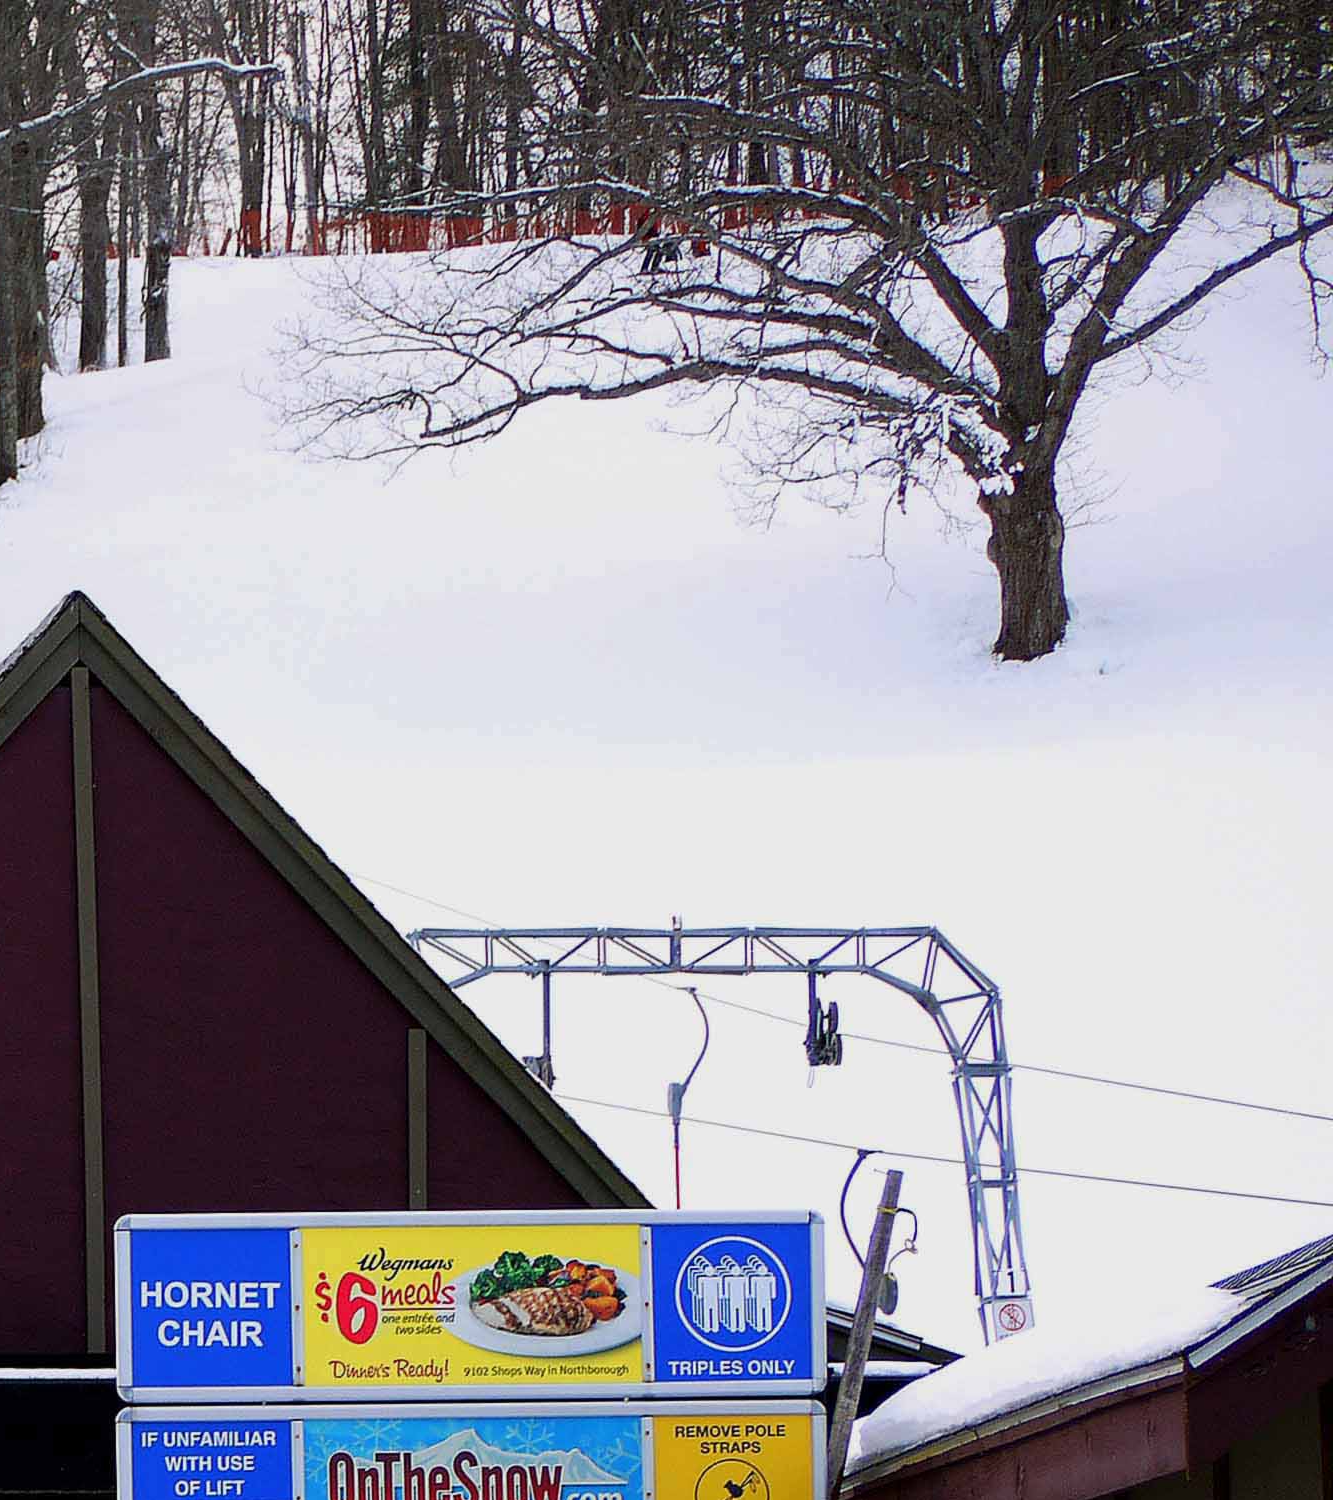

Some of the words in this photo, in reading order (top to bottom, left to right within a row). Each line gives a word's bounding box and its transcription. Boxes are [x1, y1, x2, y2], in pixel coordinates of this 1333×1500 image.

[357, 1247, 454, 1281] Wegmans
[1007, 1271, 1015, 1293] 1
[140, 1281, 281, 1309] HORNET
[315, 1272, 378, 1344] $6
[381, 1271, 456, 1306] meals
[381, 1315, 400, 1324] one
[435, 1313, 455, 1324] and
[157, 1319, 264, 1347] CHAIR
[395, 1325, 415, 1335] two
[416, 1324, 442, 1335] sides
[329, 1360, 390, 1379] Dinner's
[393, 1359, 449, 1383] Ready!
[463, 1366, 489, 1377] 9102
[490, 1365, 523, 1377] Shops
[524, 1365, 546, 1378] Way
[547, 1364, 558, 1376] in
[559, 1364, 630, 1377] Northborough
[668, 1360, 744, 1376] TRIPLES
[747, 1359, 795, 1375] ONLY
[141, 1431, 159, 1448] IF
[163, 1431, 277, 1448] UNFAMILIAR
[675, 1425, 741, 1438] REMOVE
[745, 1424, 786, 1437] POLE
[700, 1441, 761, 1454] STRAPS
[165, 1456, 213, 1472] WITH
[217, 1455, 256, 1471] USE
[174, 1480, 201, 1496] OF
[205, 1480, 245, 1496] LIFT
